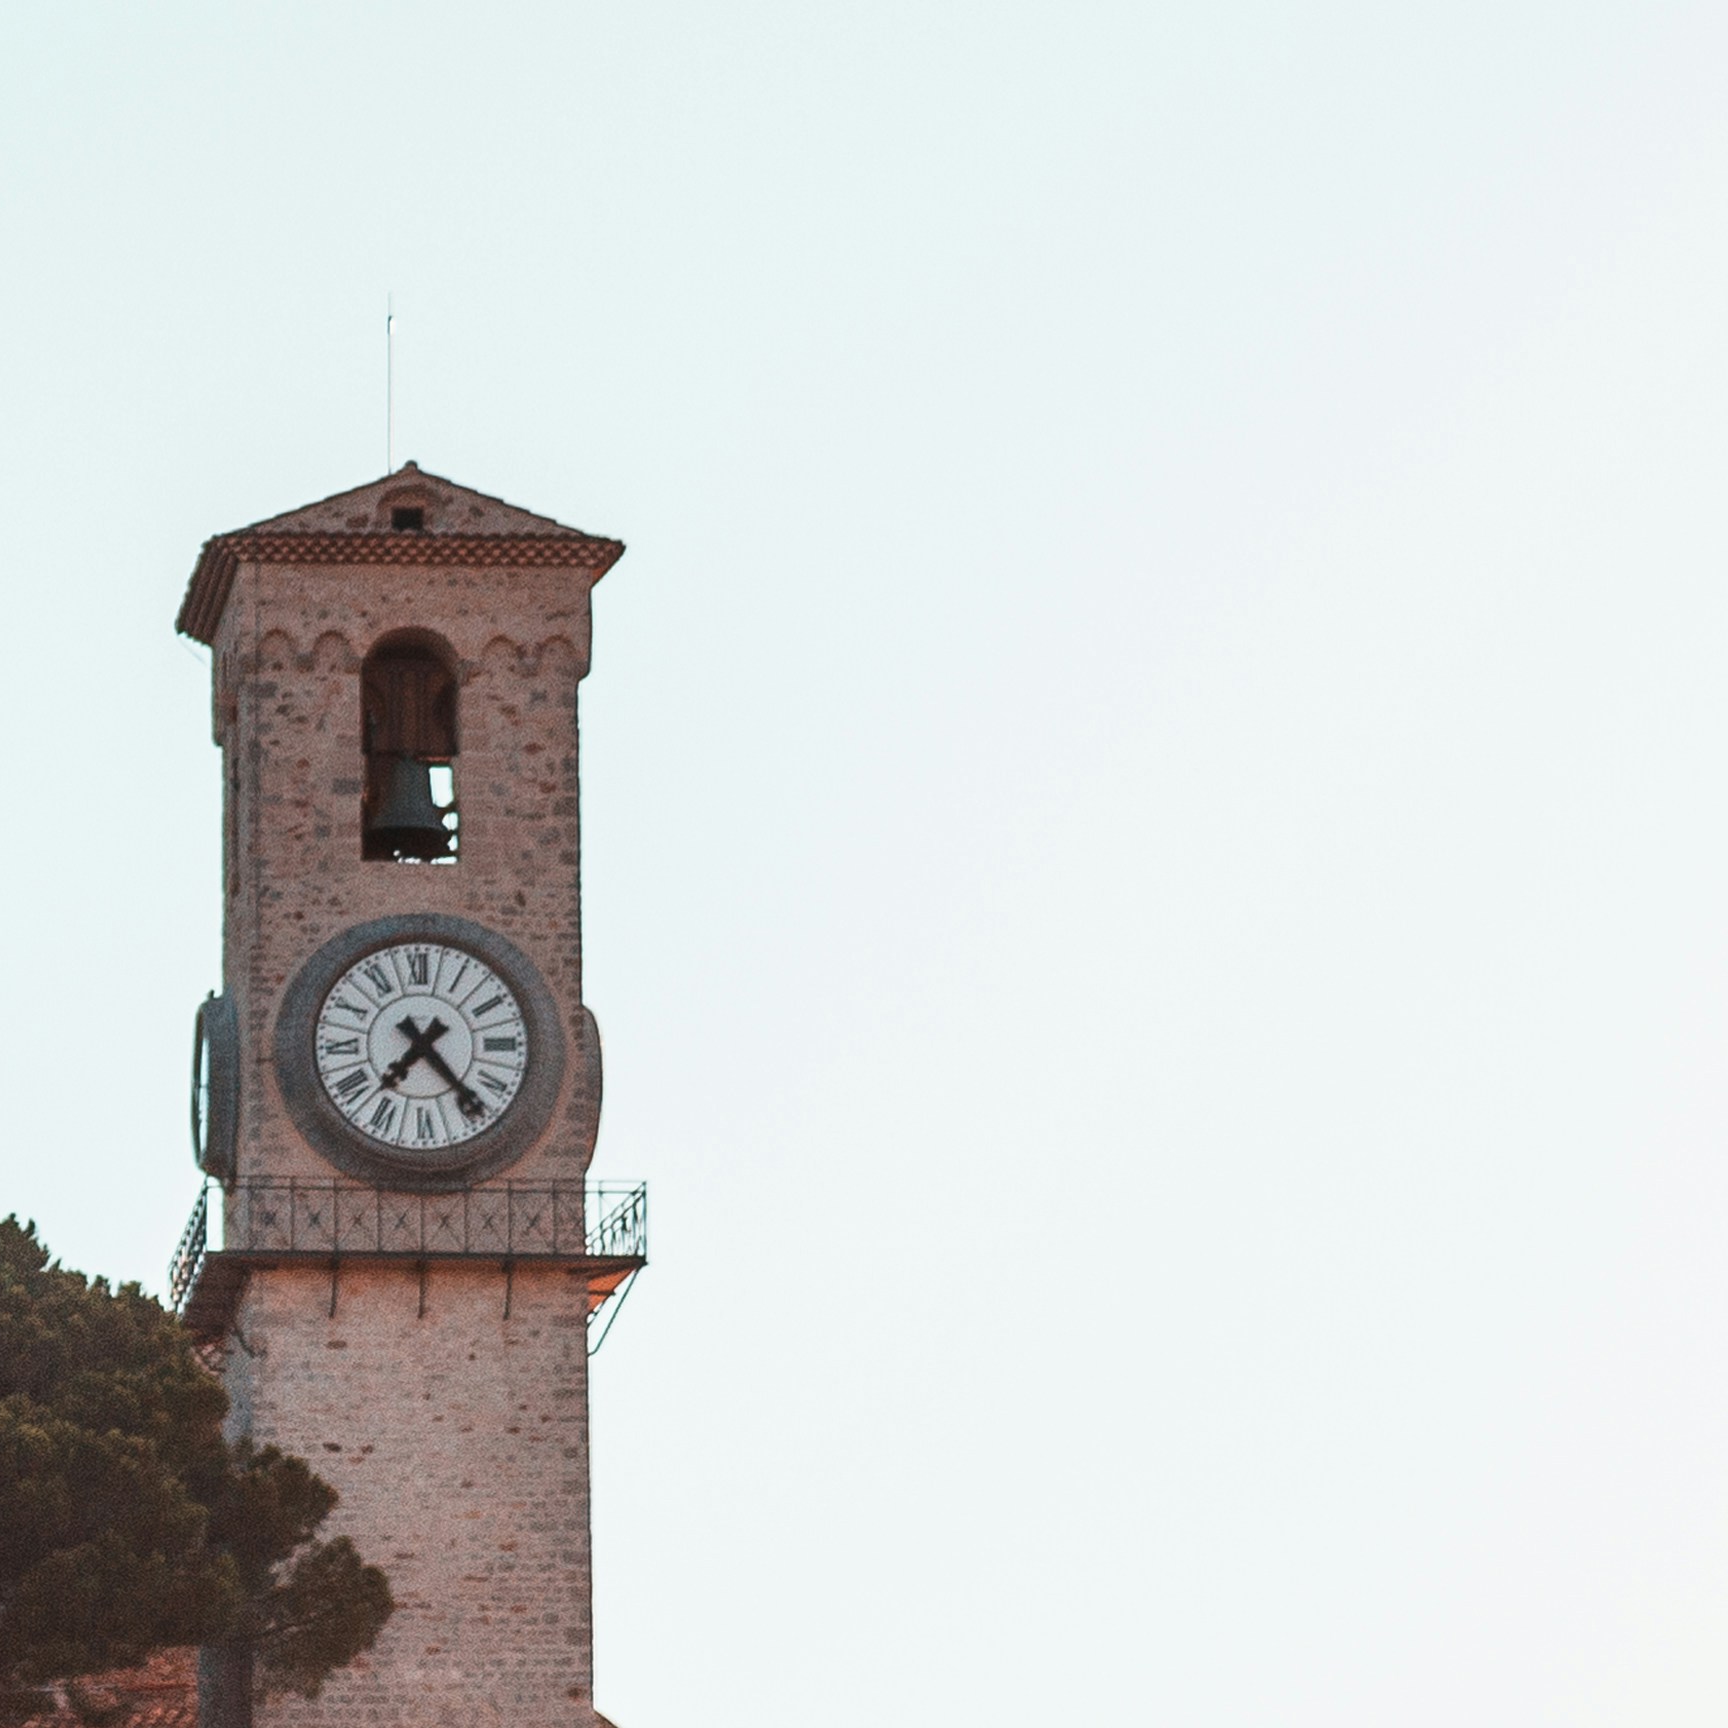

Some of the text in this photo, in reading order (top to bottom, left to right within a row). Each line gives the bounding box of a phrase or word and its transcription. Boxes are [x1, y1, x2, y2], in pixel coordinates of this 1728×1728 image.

[363, 963, 392, 997] XI
[406, 953, 428, 985] XII
[448, 963, 467, 993] I
[334, 997, 368, 1021] X
[472, 995, 505, 1018] II
[325, 1038, 359, 1054] IX
[484, 1036, 516, 1051] III
[334, 1068, 370, 1105] VIII
[369, 1097, 396, 1134] VII
[417, 1106, 434, 1139] VI
